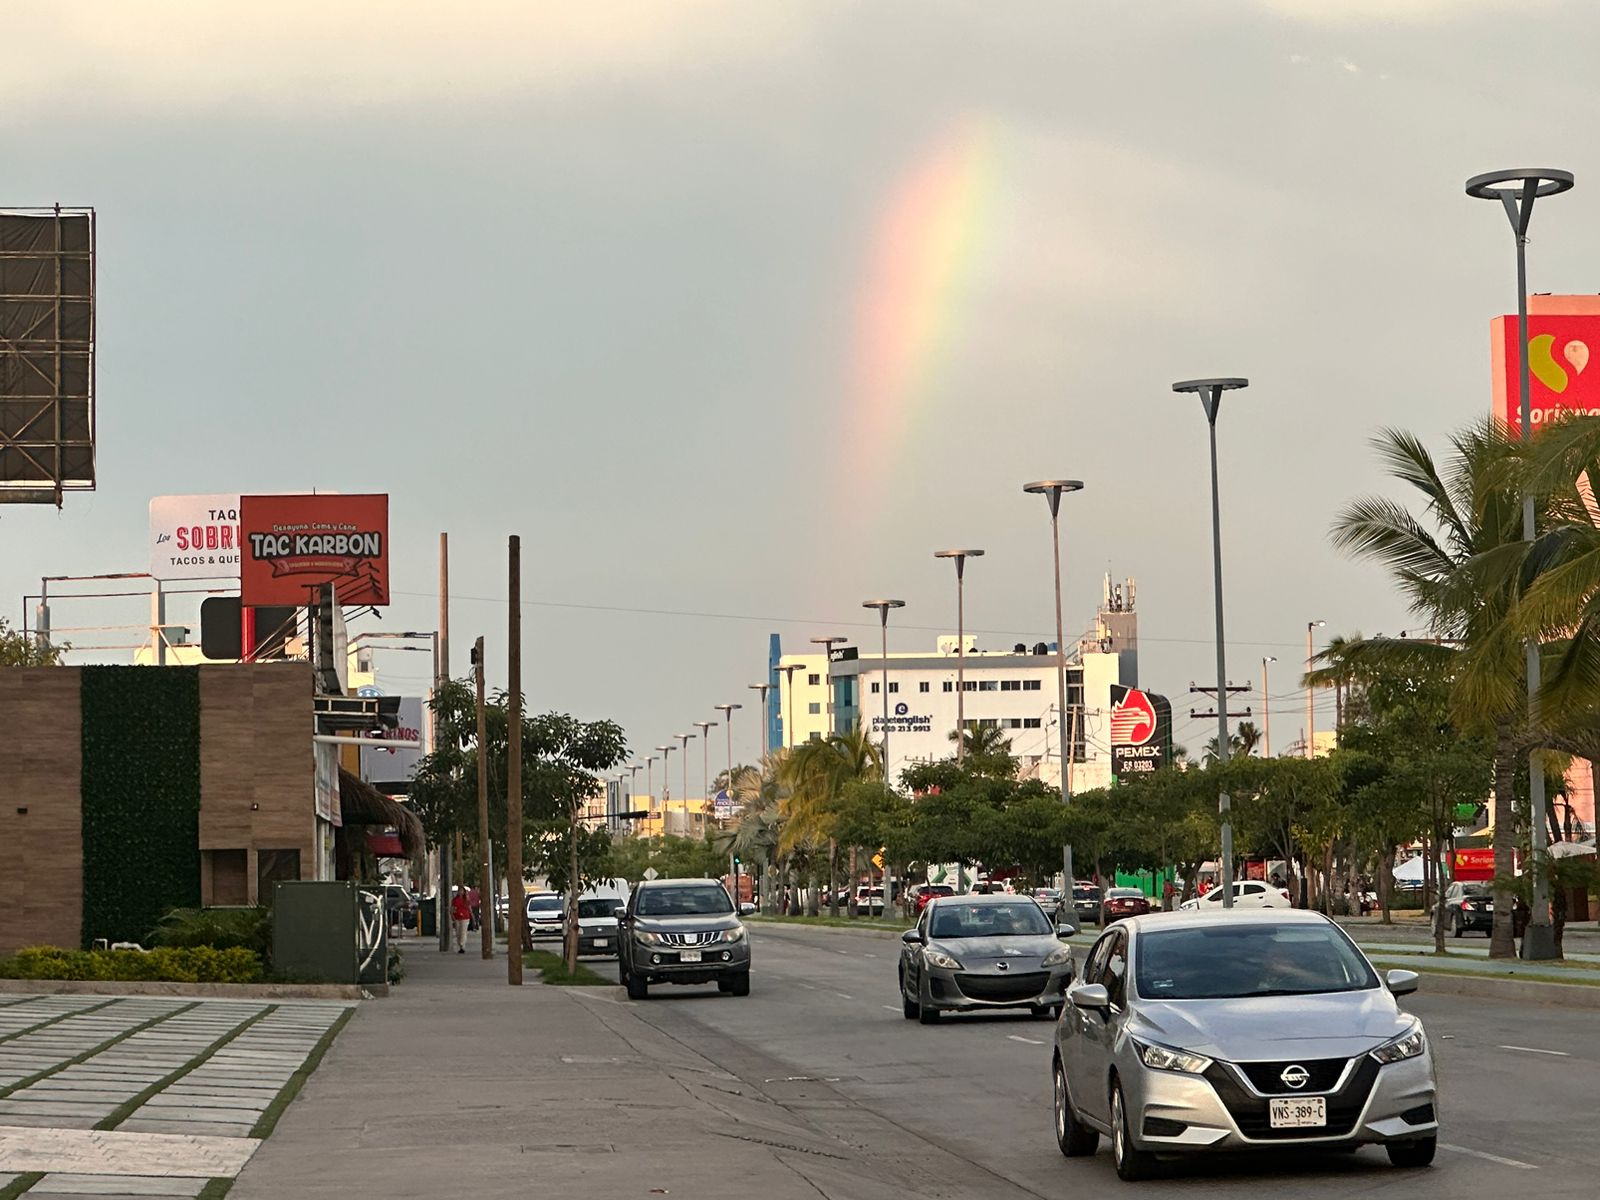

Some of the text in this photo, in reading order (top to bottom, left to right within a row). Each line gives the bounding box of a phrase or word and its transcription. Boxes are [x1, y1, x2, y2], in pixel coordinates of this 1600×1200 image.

[208, 509, 241, 521] TAQ
[251, 533, 380, 557] TAC KARBON
[170, 557, 205, 565] TACOS
[208, 556, 215, 564] &
[1115, 746, 1161, 758] PEMEX
[1272, 1105, 1324, 1119] VNS-389-C
